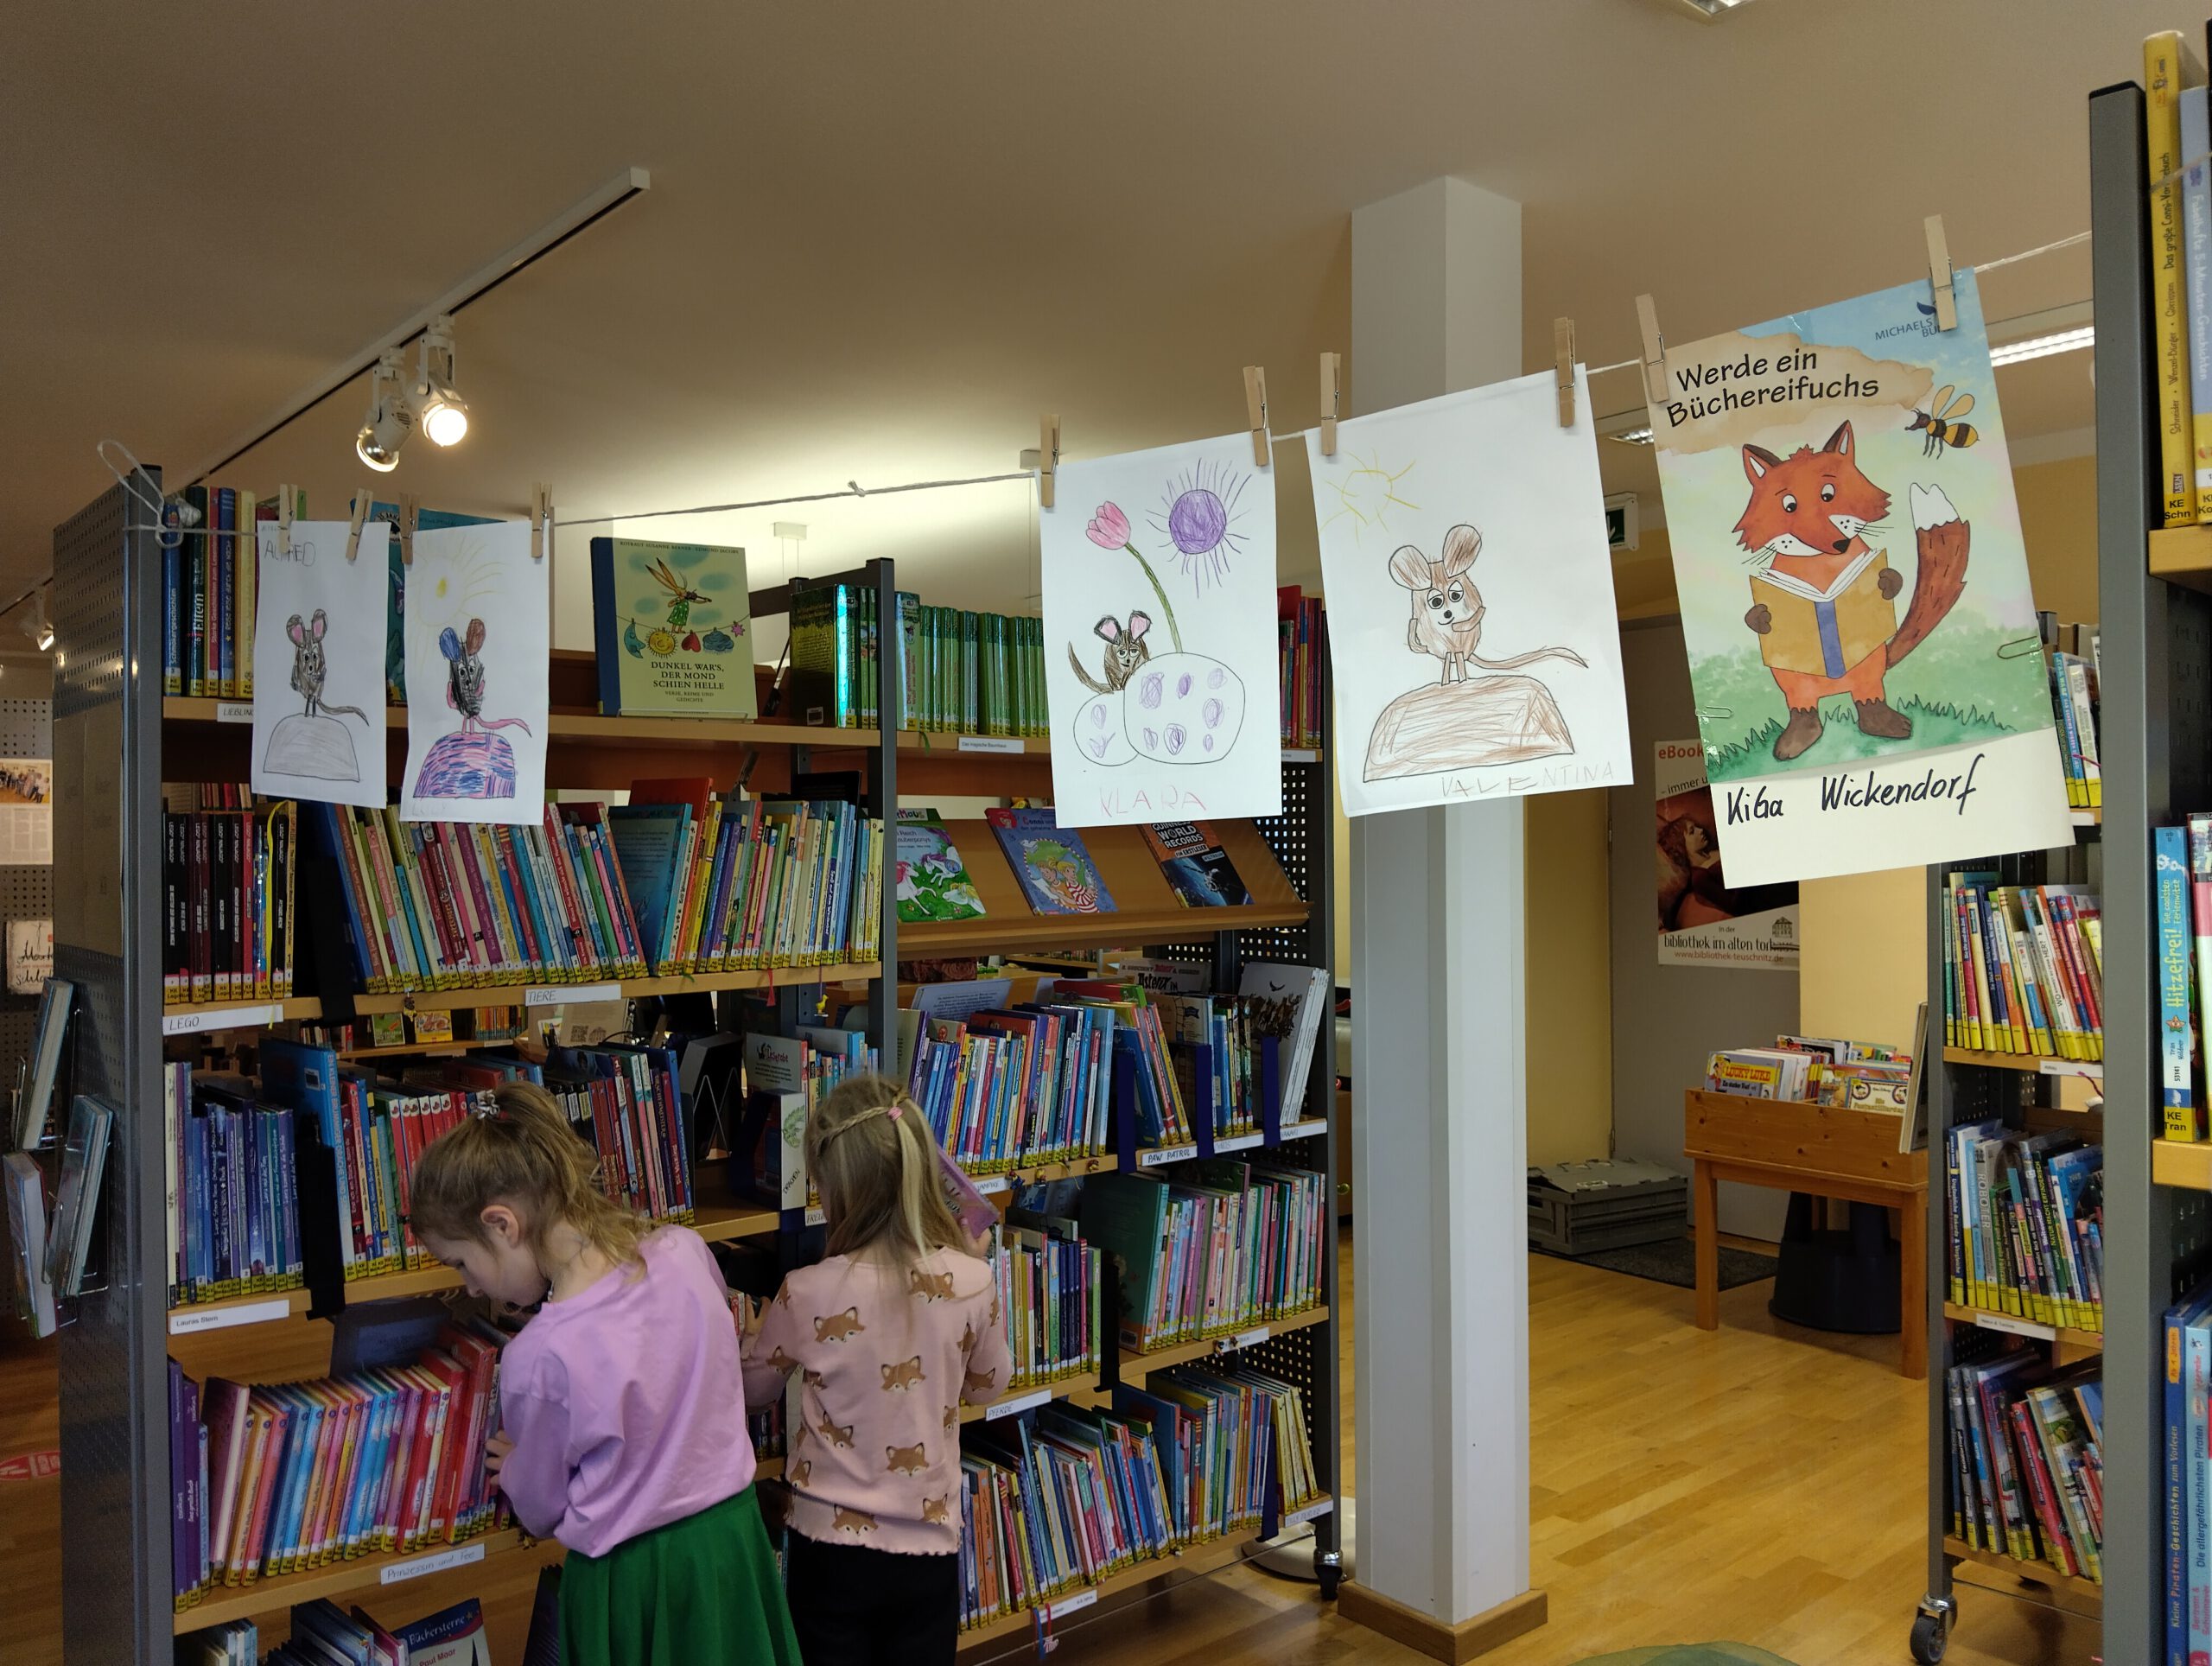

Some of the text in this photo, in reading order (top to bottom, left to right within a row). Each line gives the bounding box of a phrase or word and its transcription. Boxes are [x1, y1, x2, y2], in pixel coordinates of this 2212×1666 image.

[1875, 317, 1934, 340] MICHAELS
[1676, 347, 1818, 392] Werde ein
[1667, 373, 1880, 428] Büchereifuchs
[2170, 499, 2184, 508] KE
[2164, 511, 2190, 520] Schn
[193, 593, 205, 631] Eltern
[651, 661, 725, 673] DUNKEL WAR'S,
[661, 671, 716, 681] DER MOND
[653, 680, 725, 690] SCHIEN HELLE
[1440, 761, 1617, 798] VALENTINA
[1668, 778, 1700, 795] immer
[1821, 754, 1986, 817] Wickendorf
[1158, 824, 1198, 842] WORLD
[1164, 833, 1204, 849] RECORDS
[1664, 934, 1710, 949] bibliothek
[1713, 936, 1726, 950] im
[1728, 937, 1752, 951] alten
[2164, 927, 2185, 1008] Hitzefrei!
[1138, 972, 1173, 990] Asterix
[169, 1016, 200, 1031] LEGO
[1726, 1066, 1771, 1082] LUCKY LUKE
[2167, 1111, 2182, 1121] KE
[1147, 1149, 1191, 1164] PAW PATROL
[1975, 1172, 1990, 1230] ROBOTER
[176, 1319, 200, 1327] Lauras
[988, 1402, 1014, 1419] PFERDE
[388, 1563, 435, 1580] Prinzessin
[439, 1555, 454, 1567] und
